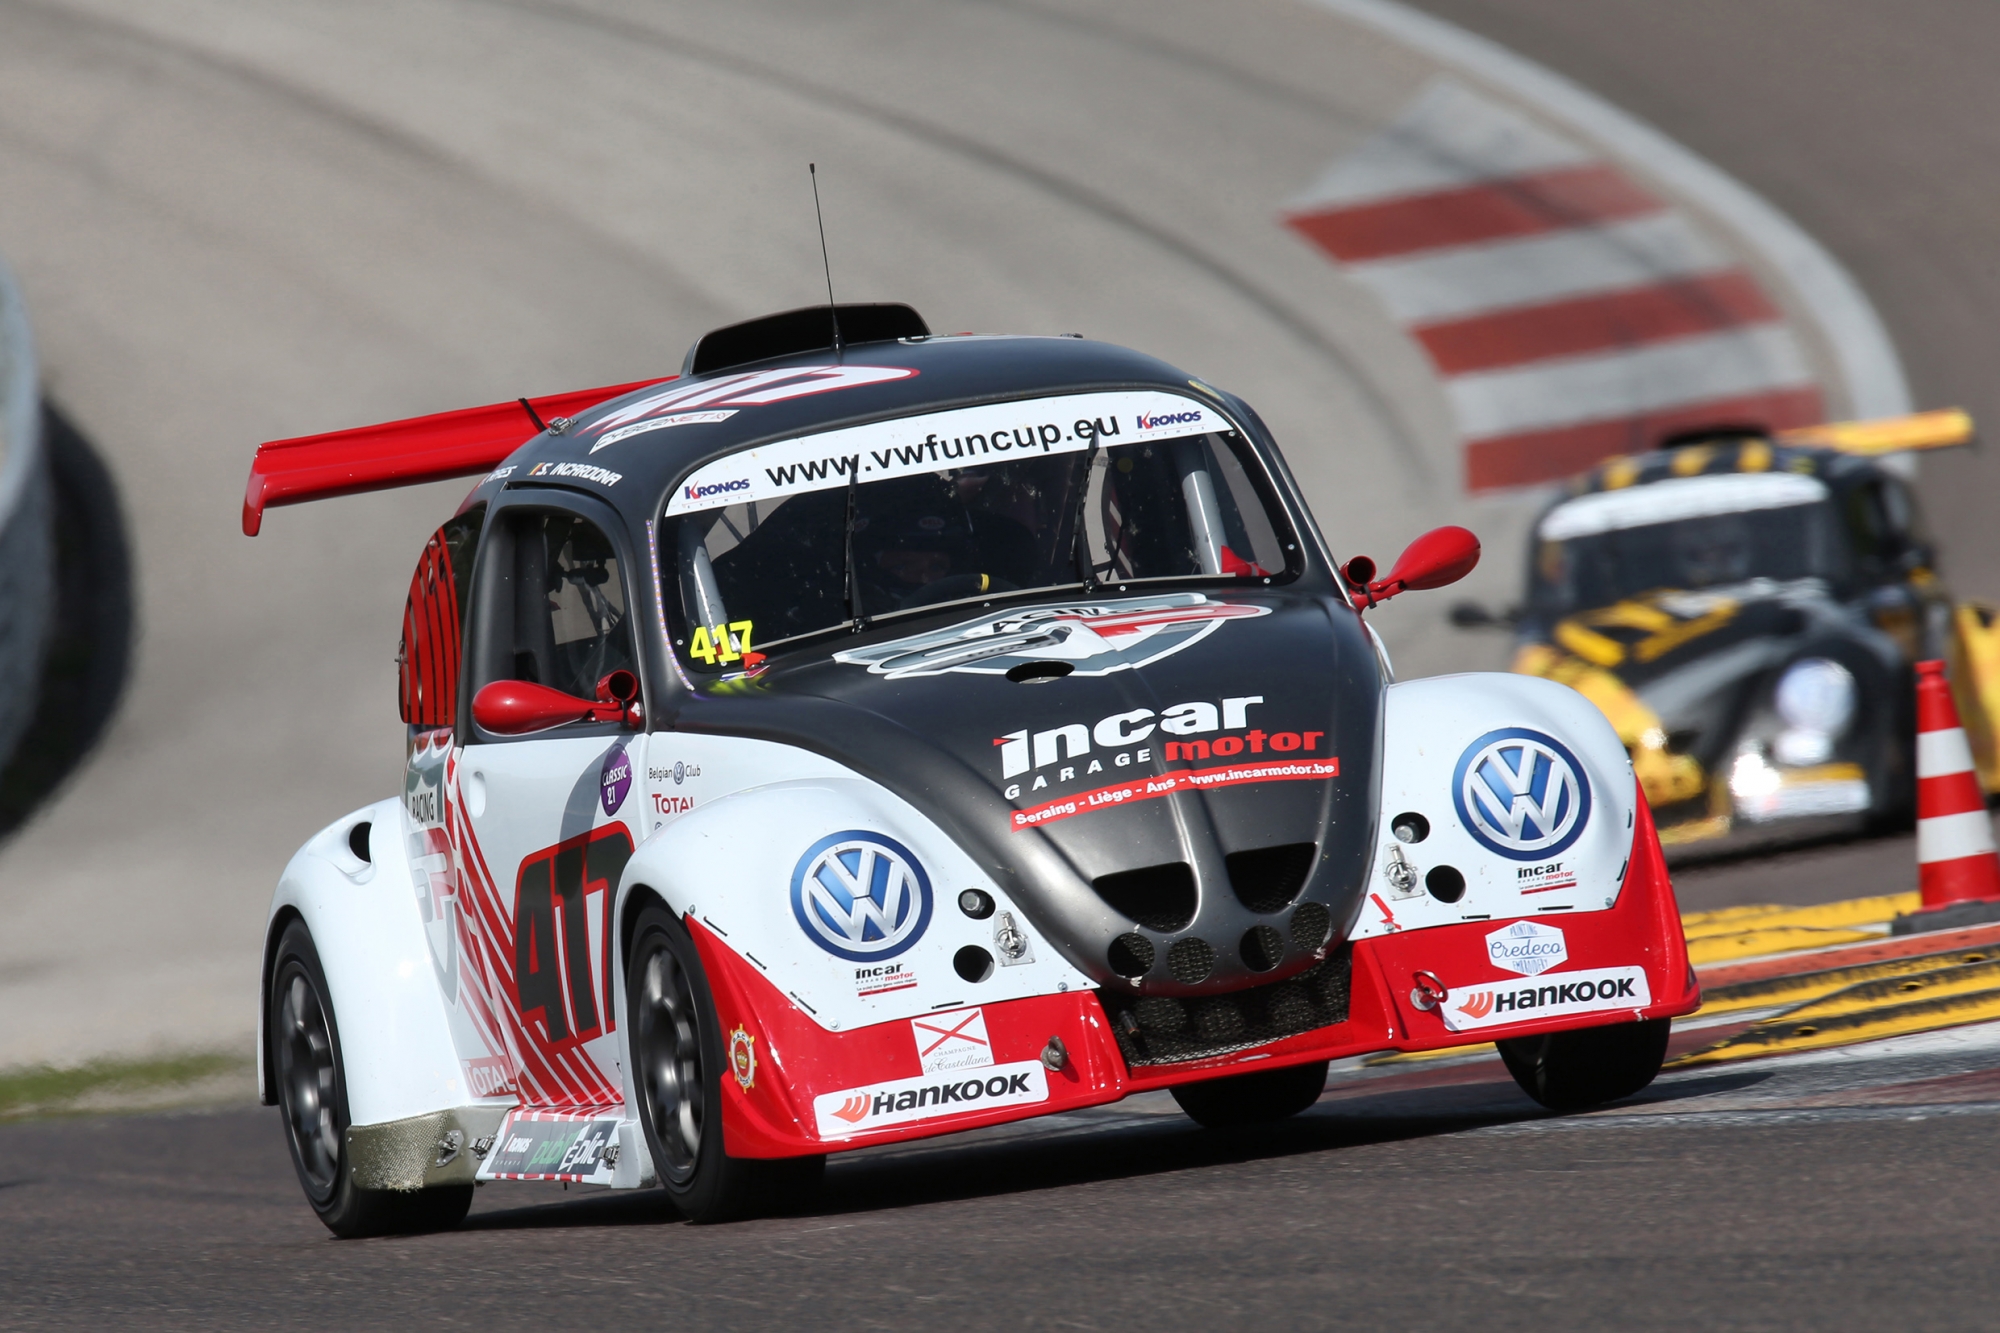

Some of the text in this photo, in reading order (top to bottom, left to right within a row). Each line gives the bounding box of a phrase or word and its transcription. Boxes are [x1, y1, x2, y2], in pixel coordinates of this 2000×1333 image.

[1136, 410, 1202, 430] KRONOS
[765, 416, 1121, 487] www.vwfuncup.eu
[550, 462, 623, 487] INCARDONA
[684, 479, 751, 500] KRONOS
[690, 620, 753, 665] 417
[1001, 695, 1264, 780] incar
[1165, 730, 1325, 761] motor
[602, 763, 628, 787] CLASSIC
[649, 766, 673, 782] Belgian
[685, 764, 701, 777] Club
[1004, 748, 1152, 800] GARAGE
[607, 786, 616, 805] 21
[1015, 802, 1076, 825] Seraing
[1089, 786, 1133, 806] Liège
[1146, 777, 1176, 794] Ans
[1189, 763, 1335, 785] www.incarmotor.be
[1517, 862, 1564, 878] incar
[1546, 871, 1574, 881] motor
[515, 829, 633, 1044] 417
[1490, 939, 1563, 959] Credeco
[855, 962, 904, 979] incar
[885, 972, 914, 981] motor
[933, 1045, 977, 1058] CHAMPAGNE
[934, 1054, 990, 1071] Castellane
[461, 1060, 518, 1095] TOTAL
